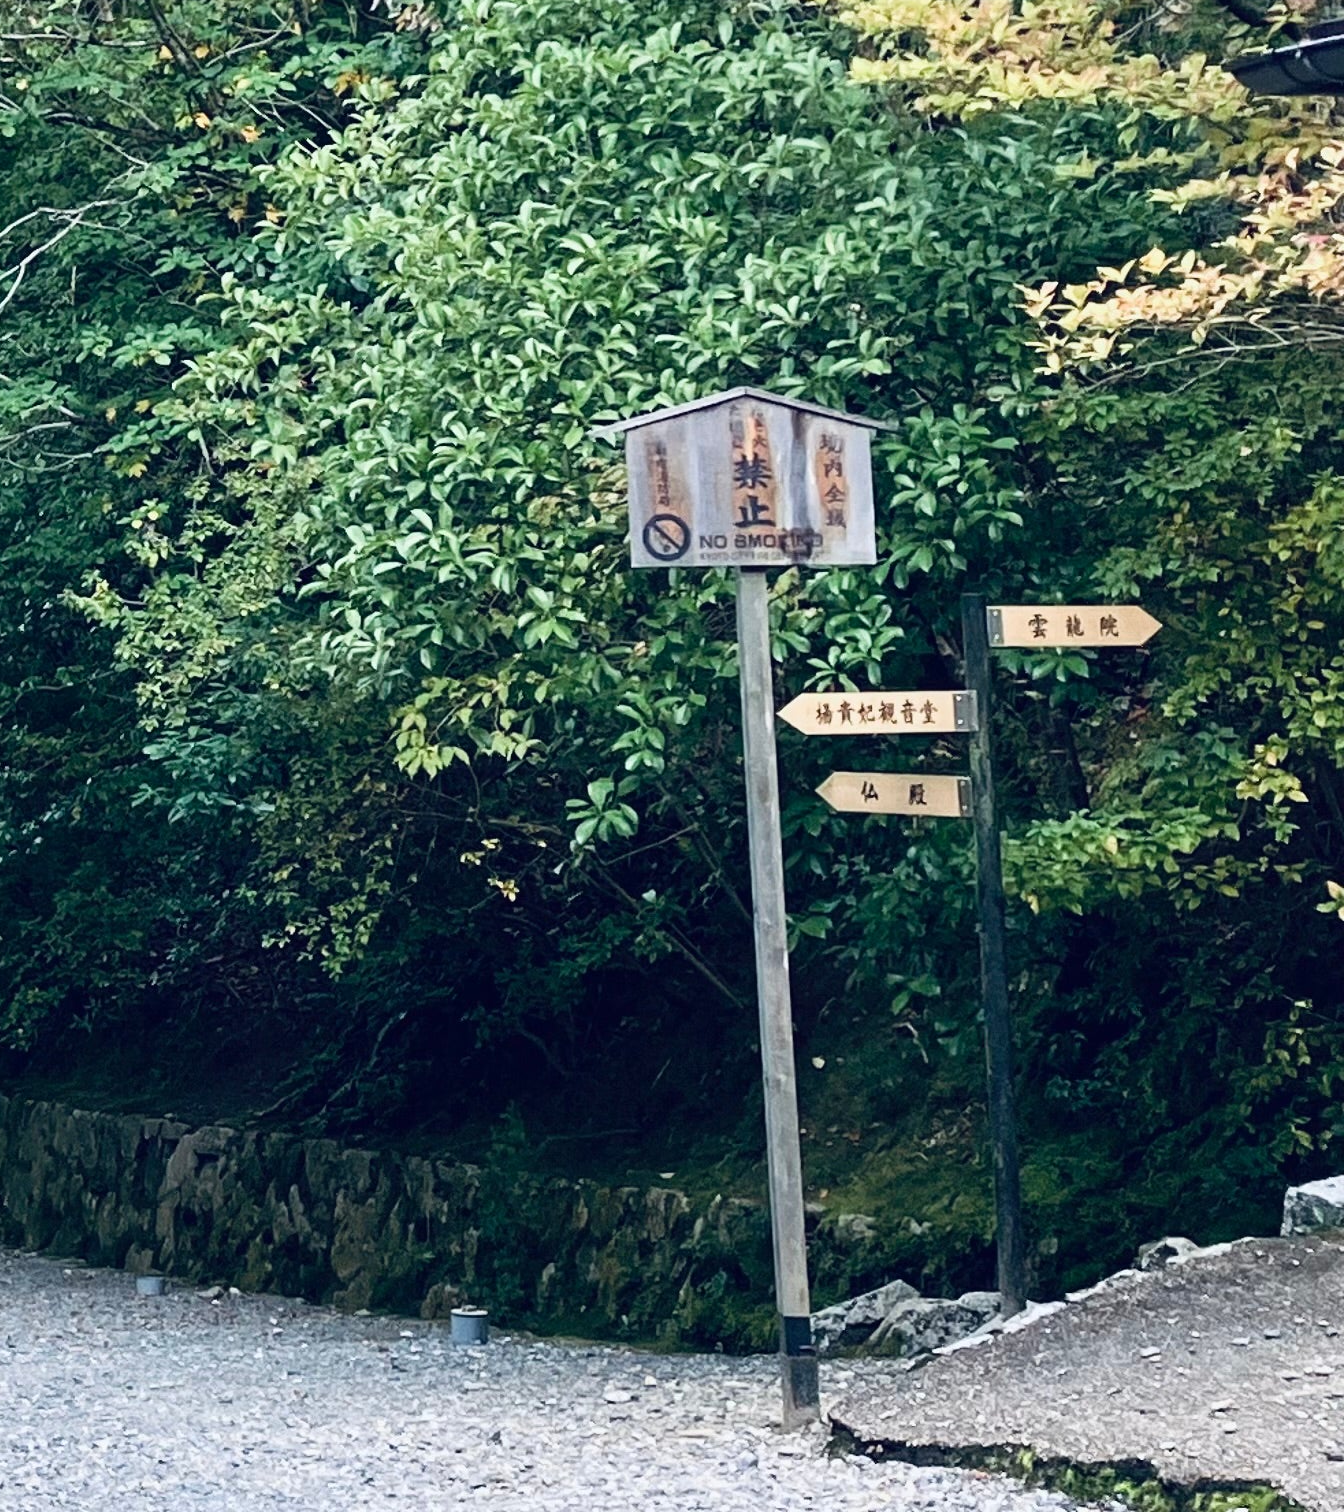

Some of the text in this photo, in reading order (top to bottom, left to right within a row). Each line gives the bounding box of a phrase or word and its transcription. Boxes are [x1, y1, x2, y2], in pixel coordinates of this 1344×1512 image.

[733, 452, 776, 528] 禁止
[699, 534, 728, 549] NO
[1028, 614, 1119, 639] 雲龍院
[816, 699, 939, 726] 楊貴妃観音堂
[860, 781, 928, 806] 仏殿
